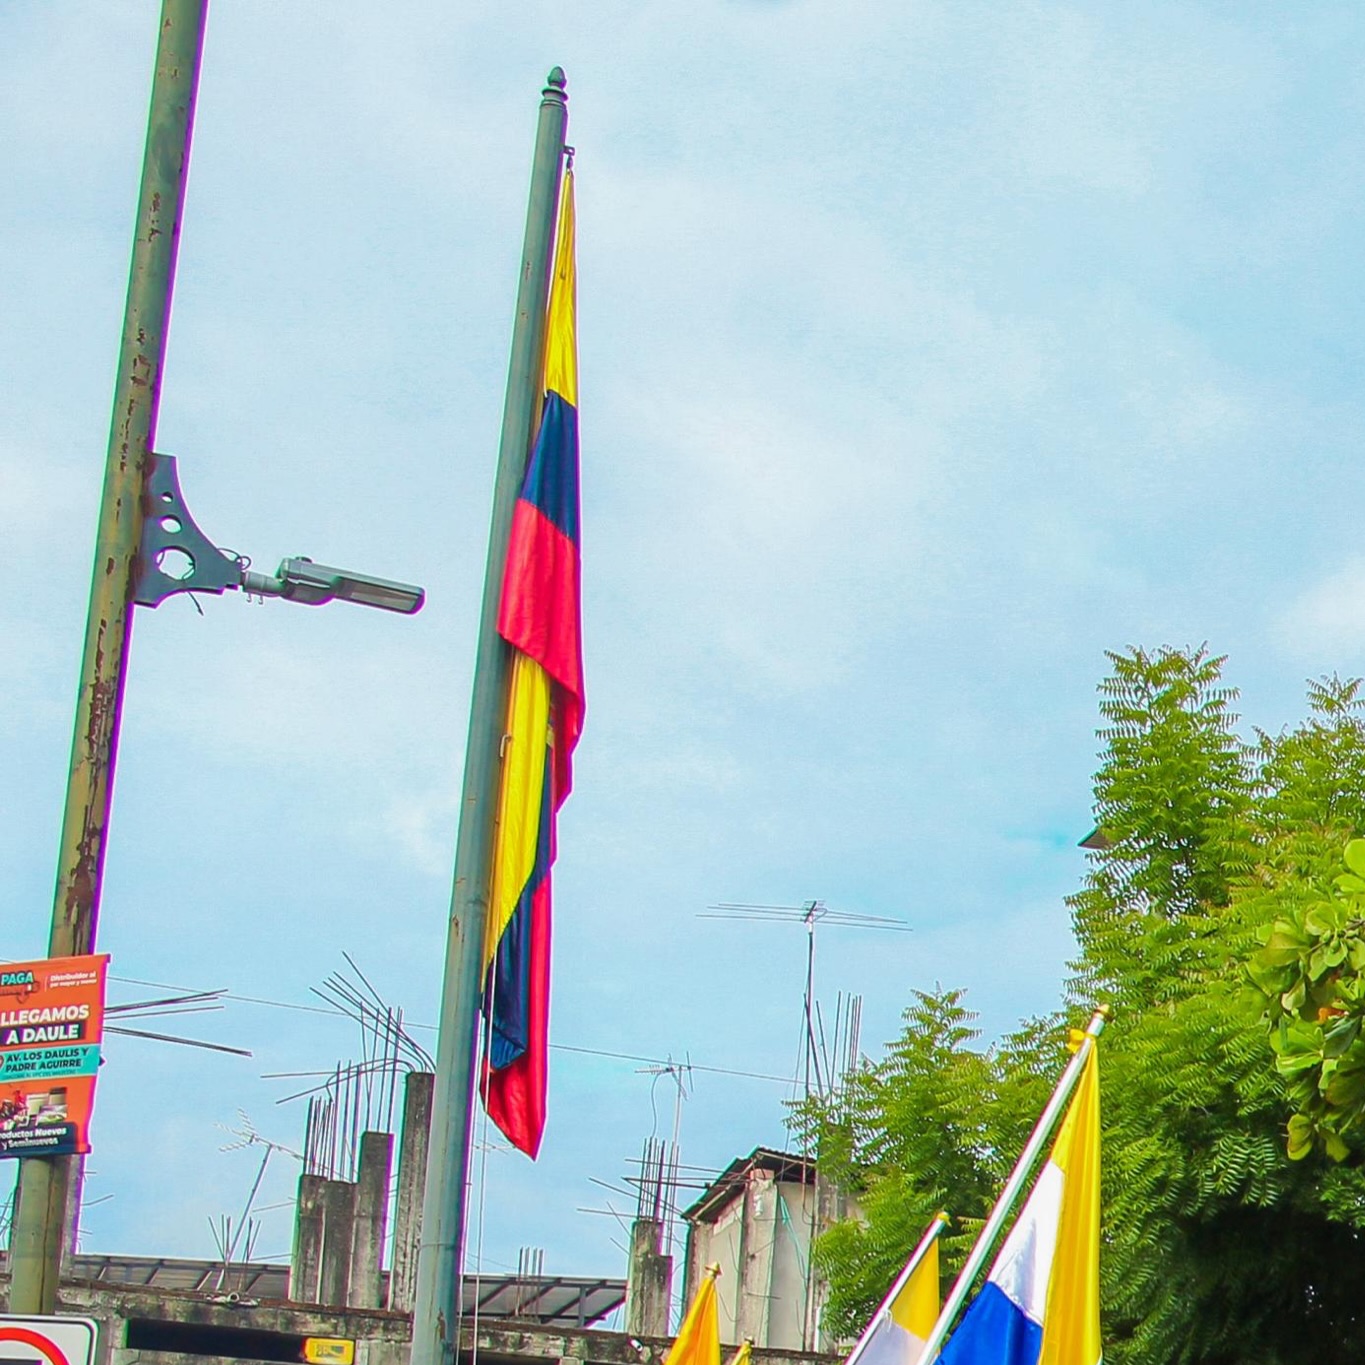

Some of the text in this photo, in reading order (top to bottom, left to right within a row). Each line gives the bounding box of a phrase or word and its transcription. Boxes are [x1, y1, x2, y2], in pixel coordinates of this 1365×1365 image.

[1, 972, 34, 985] PAGA
[0, 1004, 90, 1026] LLEGAMOS
[6, 1024, 79, 1044] A DAULE
[24, 1052, 42, 1060] LOS
[45, 1049, 79, 1058] DAULIS
[82, 1047, 90, 1056] Y
[6, 1059, 82, 1072] PADRE AGUIRRE
